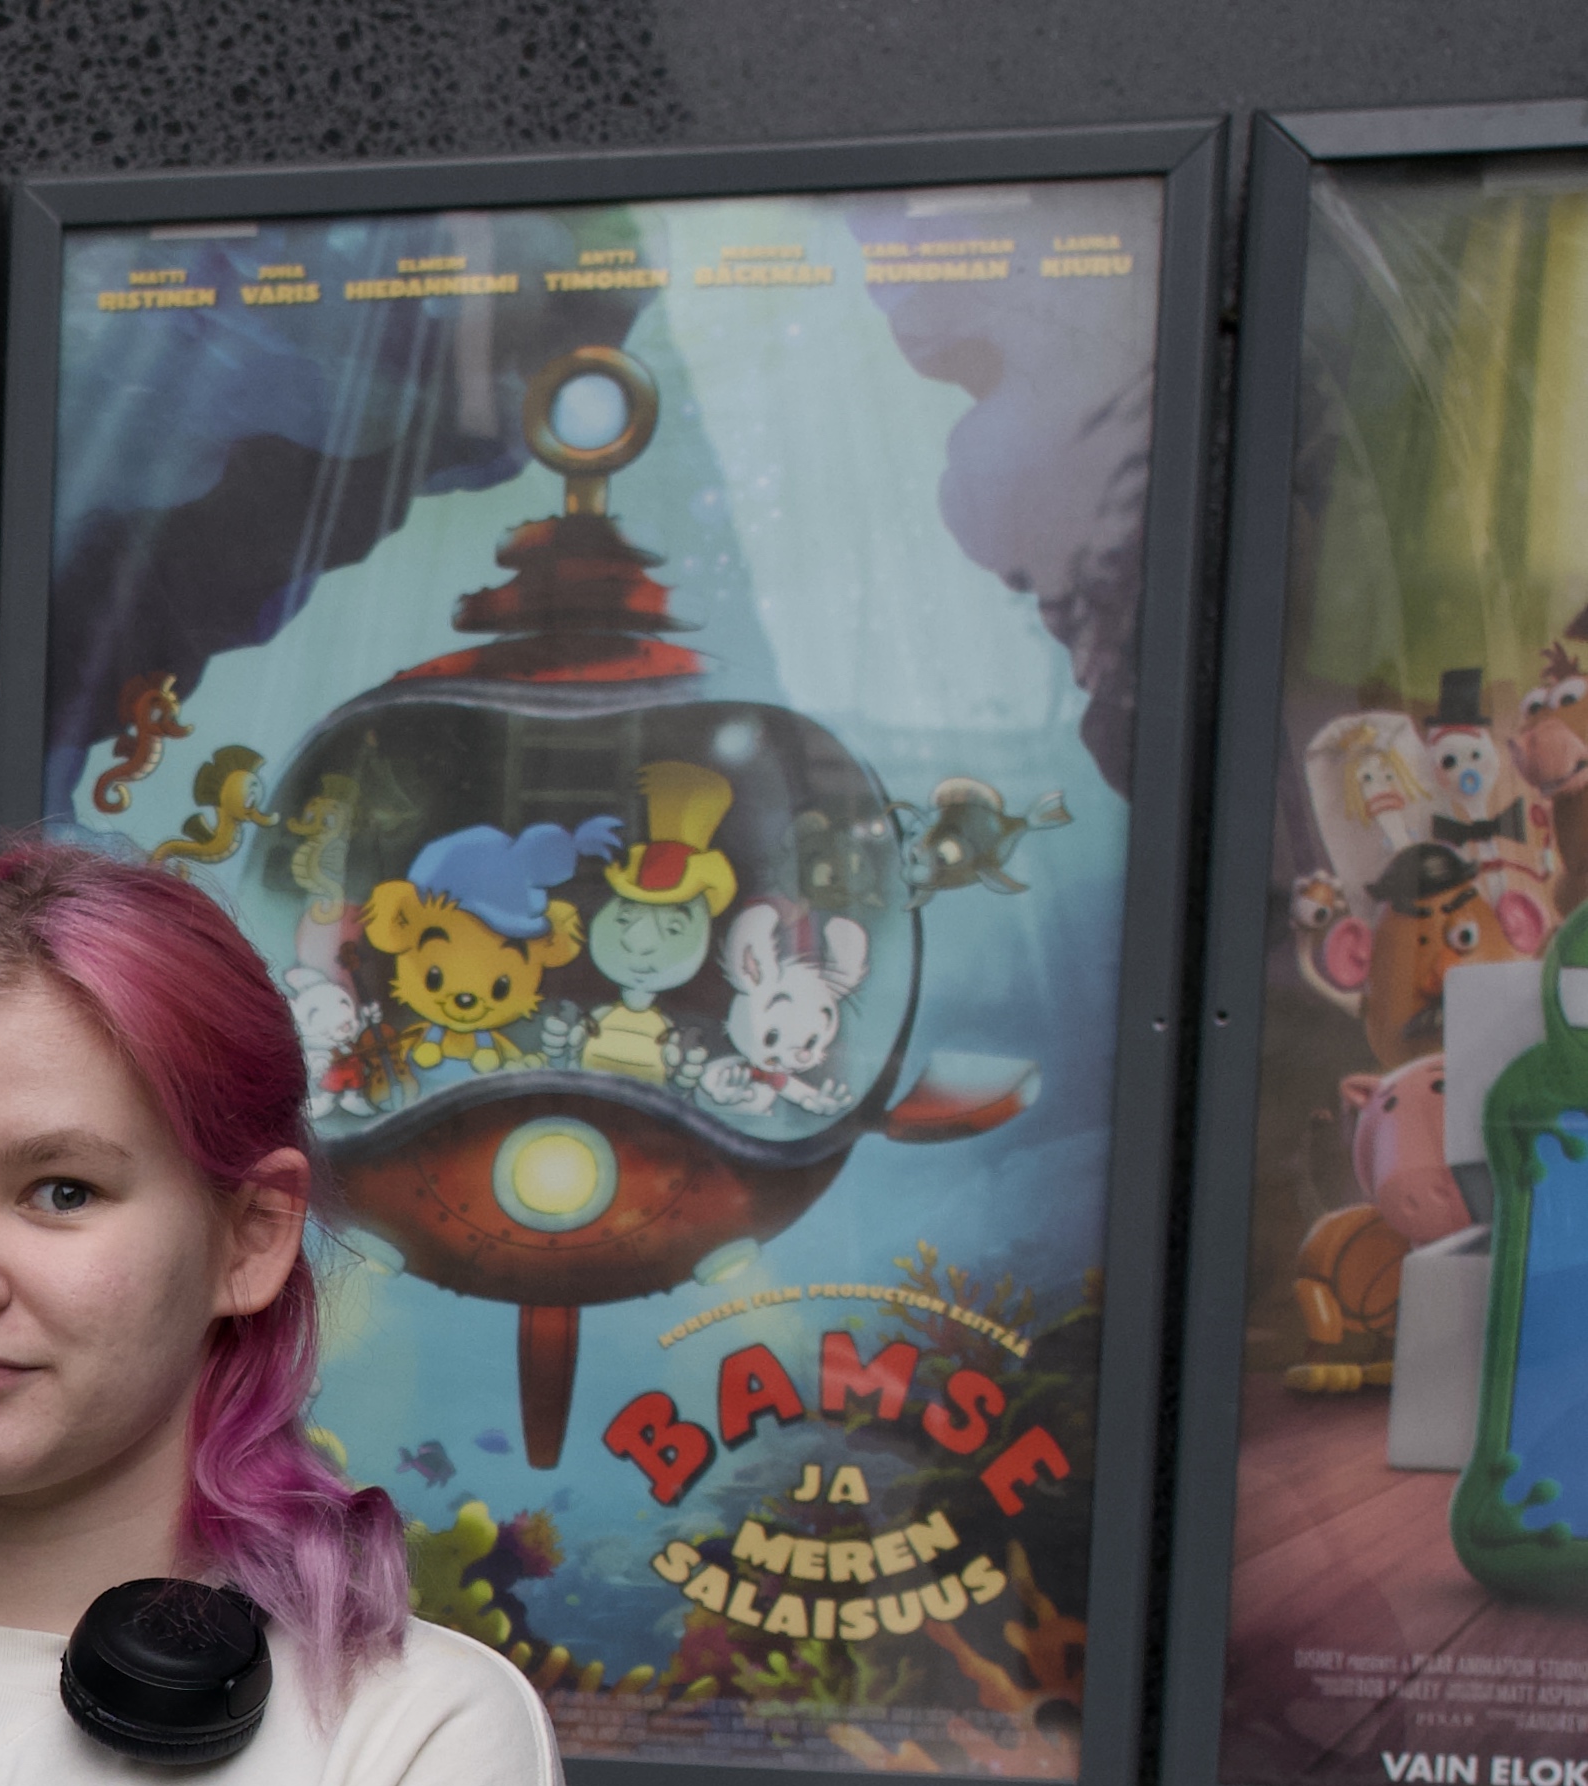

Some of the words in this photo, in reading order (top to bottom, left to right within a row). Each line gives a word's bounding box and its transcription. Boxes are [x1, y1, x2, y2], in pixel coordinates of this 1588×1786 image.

[544, 268, 668, 292] TIMONEN
[866, 260, 1009, 284] RUNDMAN
[241, 283, 319, 306] VARIS
[658, 1298, 750, 1349] NORDISK
[751, 1286, 802, 1310] FILM
[808, 1283, 946, 1318] PRODUCTION
[948, 1304, 1034, 1359] ESITTÄÄ
[602, 1330, 1071, 1518] BAMSE
[792, 1463, 870, 1506] JA
[731, 1510, 961, 1585] MEREN
[650, 1539, 1007, 1642] SALAISUUS
[1380, 1751, 1478, 1785] VAIN
